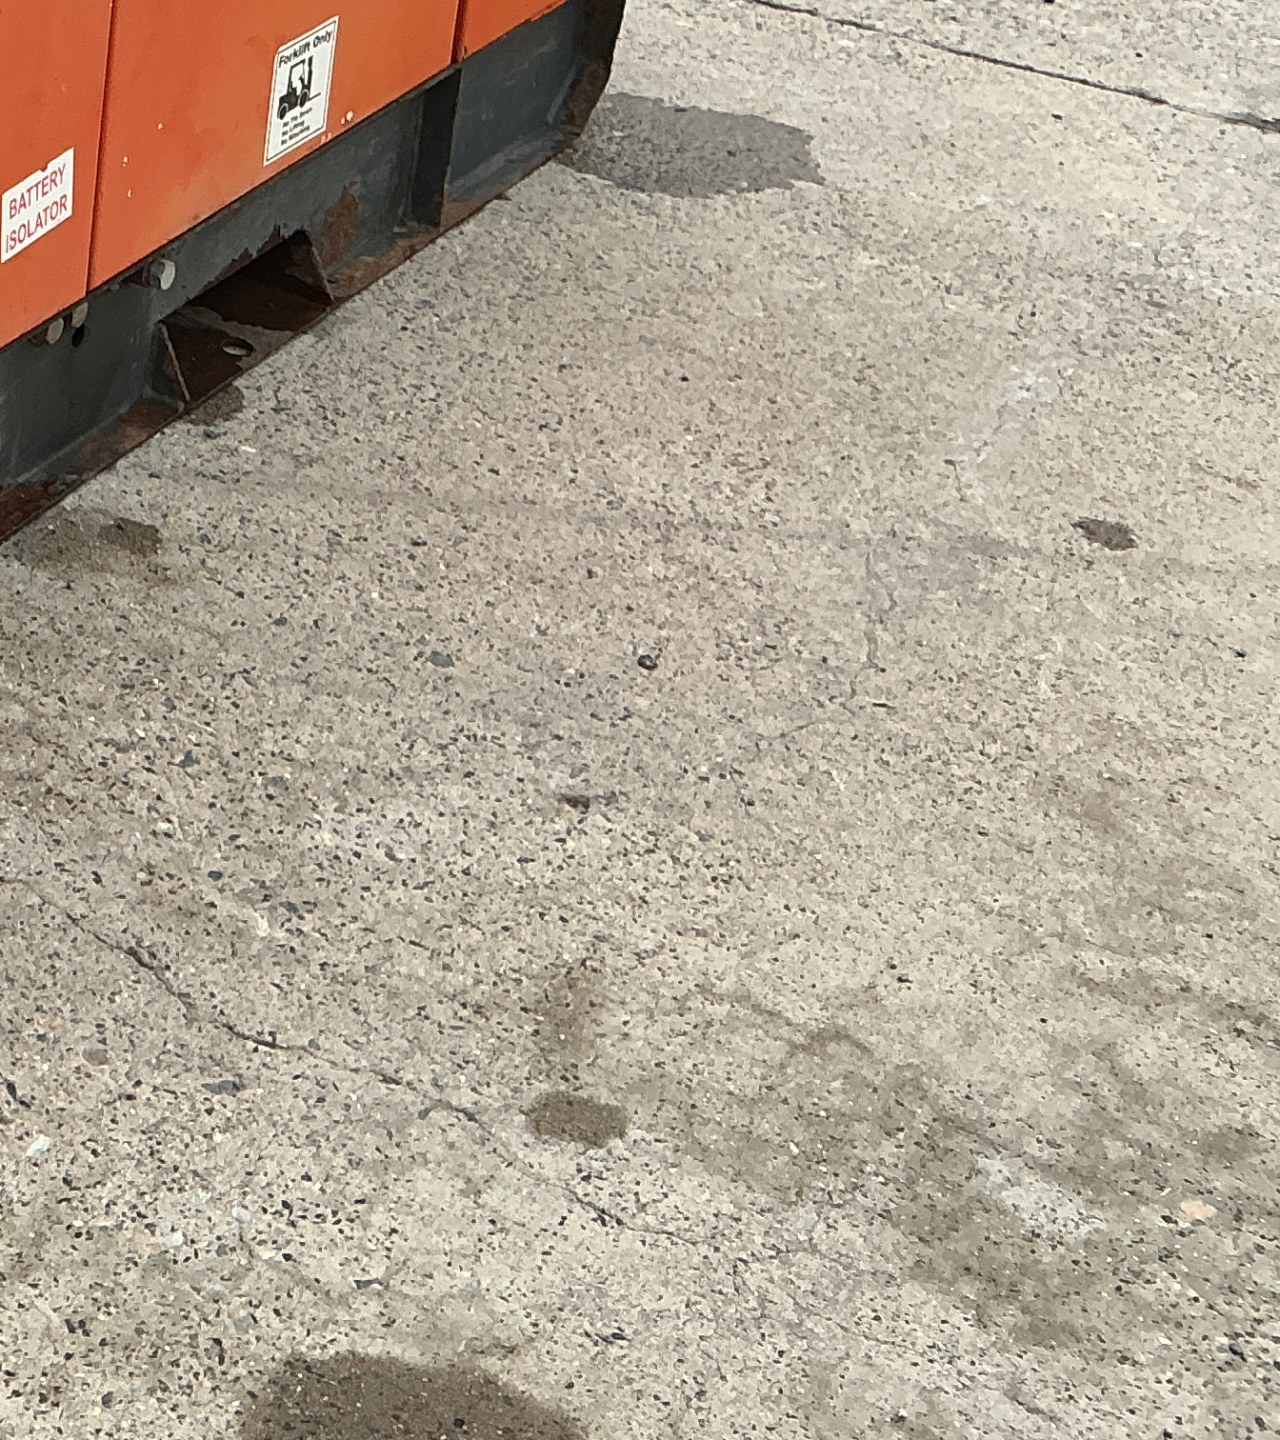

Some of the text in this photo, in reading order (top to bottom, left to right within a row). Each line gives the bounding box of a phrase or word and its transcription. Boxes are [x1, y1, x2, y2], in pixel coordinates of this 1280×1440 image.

[278, 29, 333, 68] Forklift Only
[9, 162, 66, 220] BATTERY
[5, 193, 68, 253] ISOLATOR
